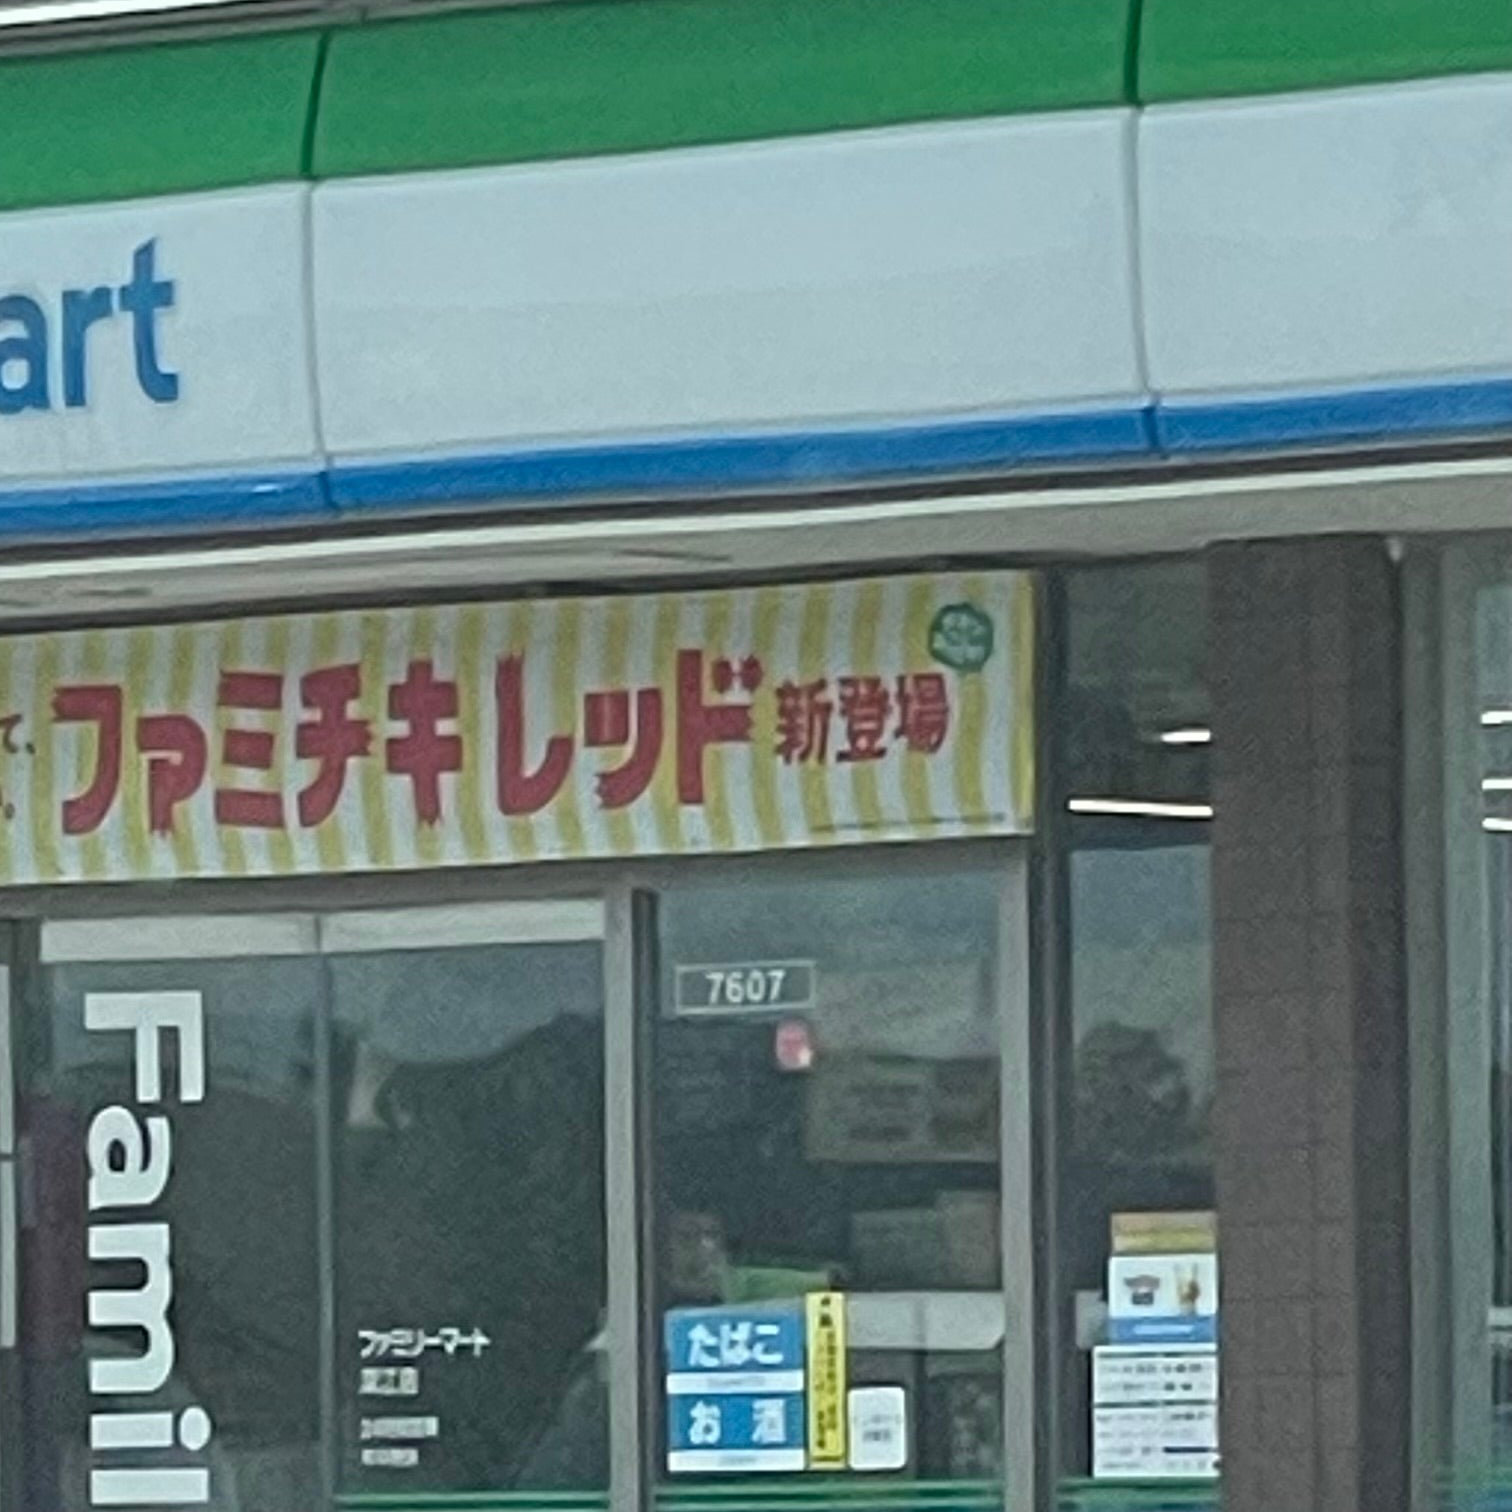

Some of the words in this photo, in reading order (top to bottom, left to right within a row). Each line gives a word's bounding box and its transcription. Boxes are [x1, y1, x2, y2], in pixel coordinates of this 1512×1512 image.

[52, 648, 764, 838] ファミチキレッド
[774, 672, 949, 765] 新登場
[705, 969, 787, 1005] 7607
[84, 990, 211, 1505] Famil
[686, 1320, 784, 1369] たばこ
[687, 1398, 788, 1445] お酒
